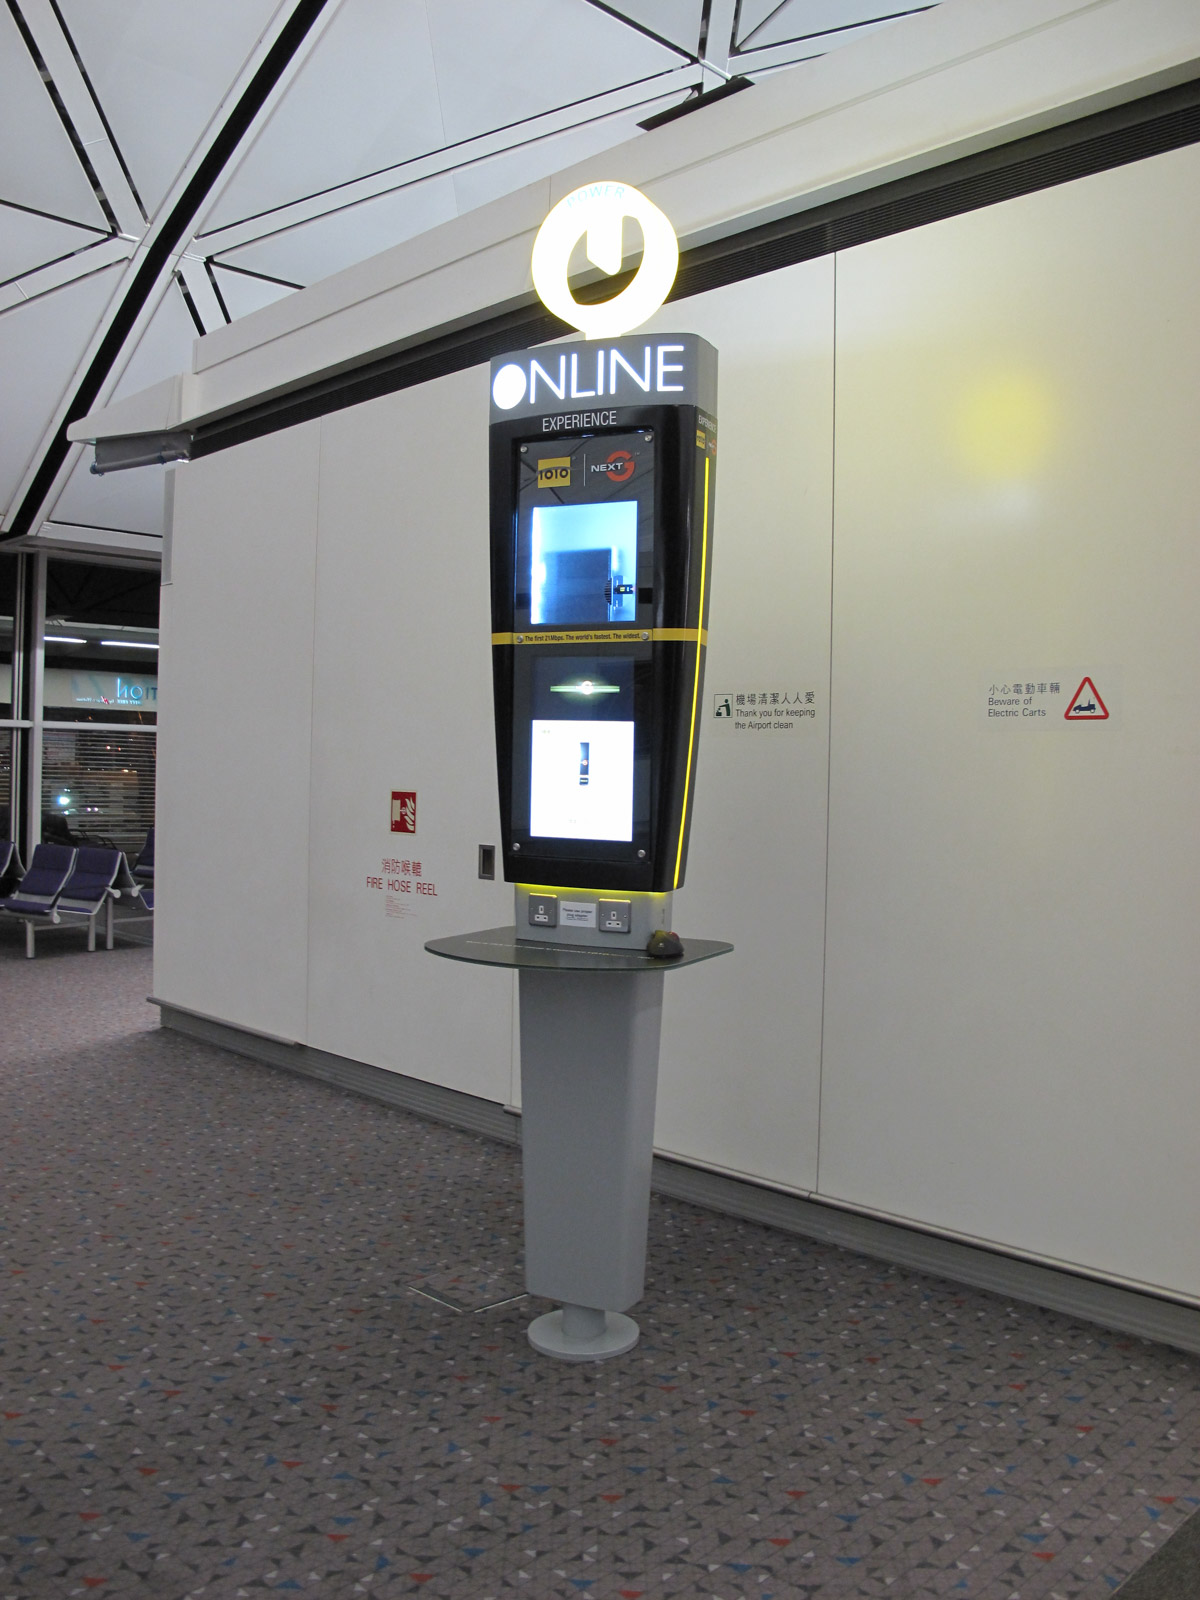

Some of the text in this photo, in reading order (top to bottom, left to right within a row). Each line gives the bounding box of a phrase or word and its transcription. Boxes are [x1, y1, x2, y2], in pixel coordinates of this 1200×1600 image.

[567, 184, 625, 208] POWER
[493, 345, 684, 410] ONLINE
[542, 411, 617, 432] EXPERIENCE
[565, 633, 575, 641] The
[575, 633, 593, 641] world's
[593, 632, 611, 640] fastest.
[612, 632, 622, 640] The
[622, 632, 641, 640] widest.
[988, 682, 1061, 695] 小心電動車輛
[735, 691, 816, 706] 機場清潔人人愛
[988, 696, 1033, 706] Beware of
[735, 709, 816, 719] Thank you for keeping
[988, 708, 1046, 717] Electric Carts
[748, 721, 771, 731] Airport
[773, 721, 793, 729] clean
[366, 876, 438, 897] FIRE HOSE REEL
